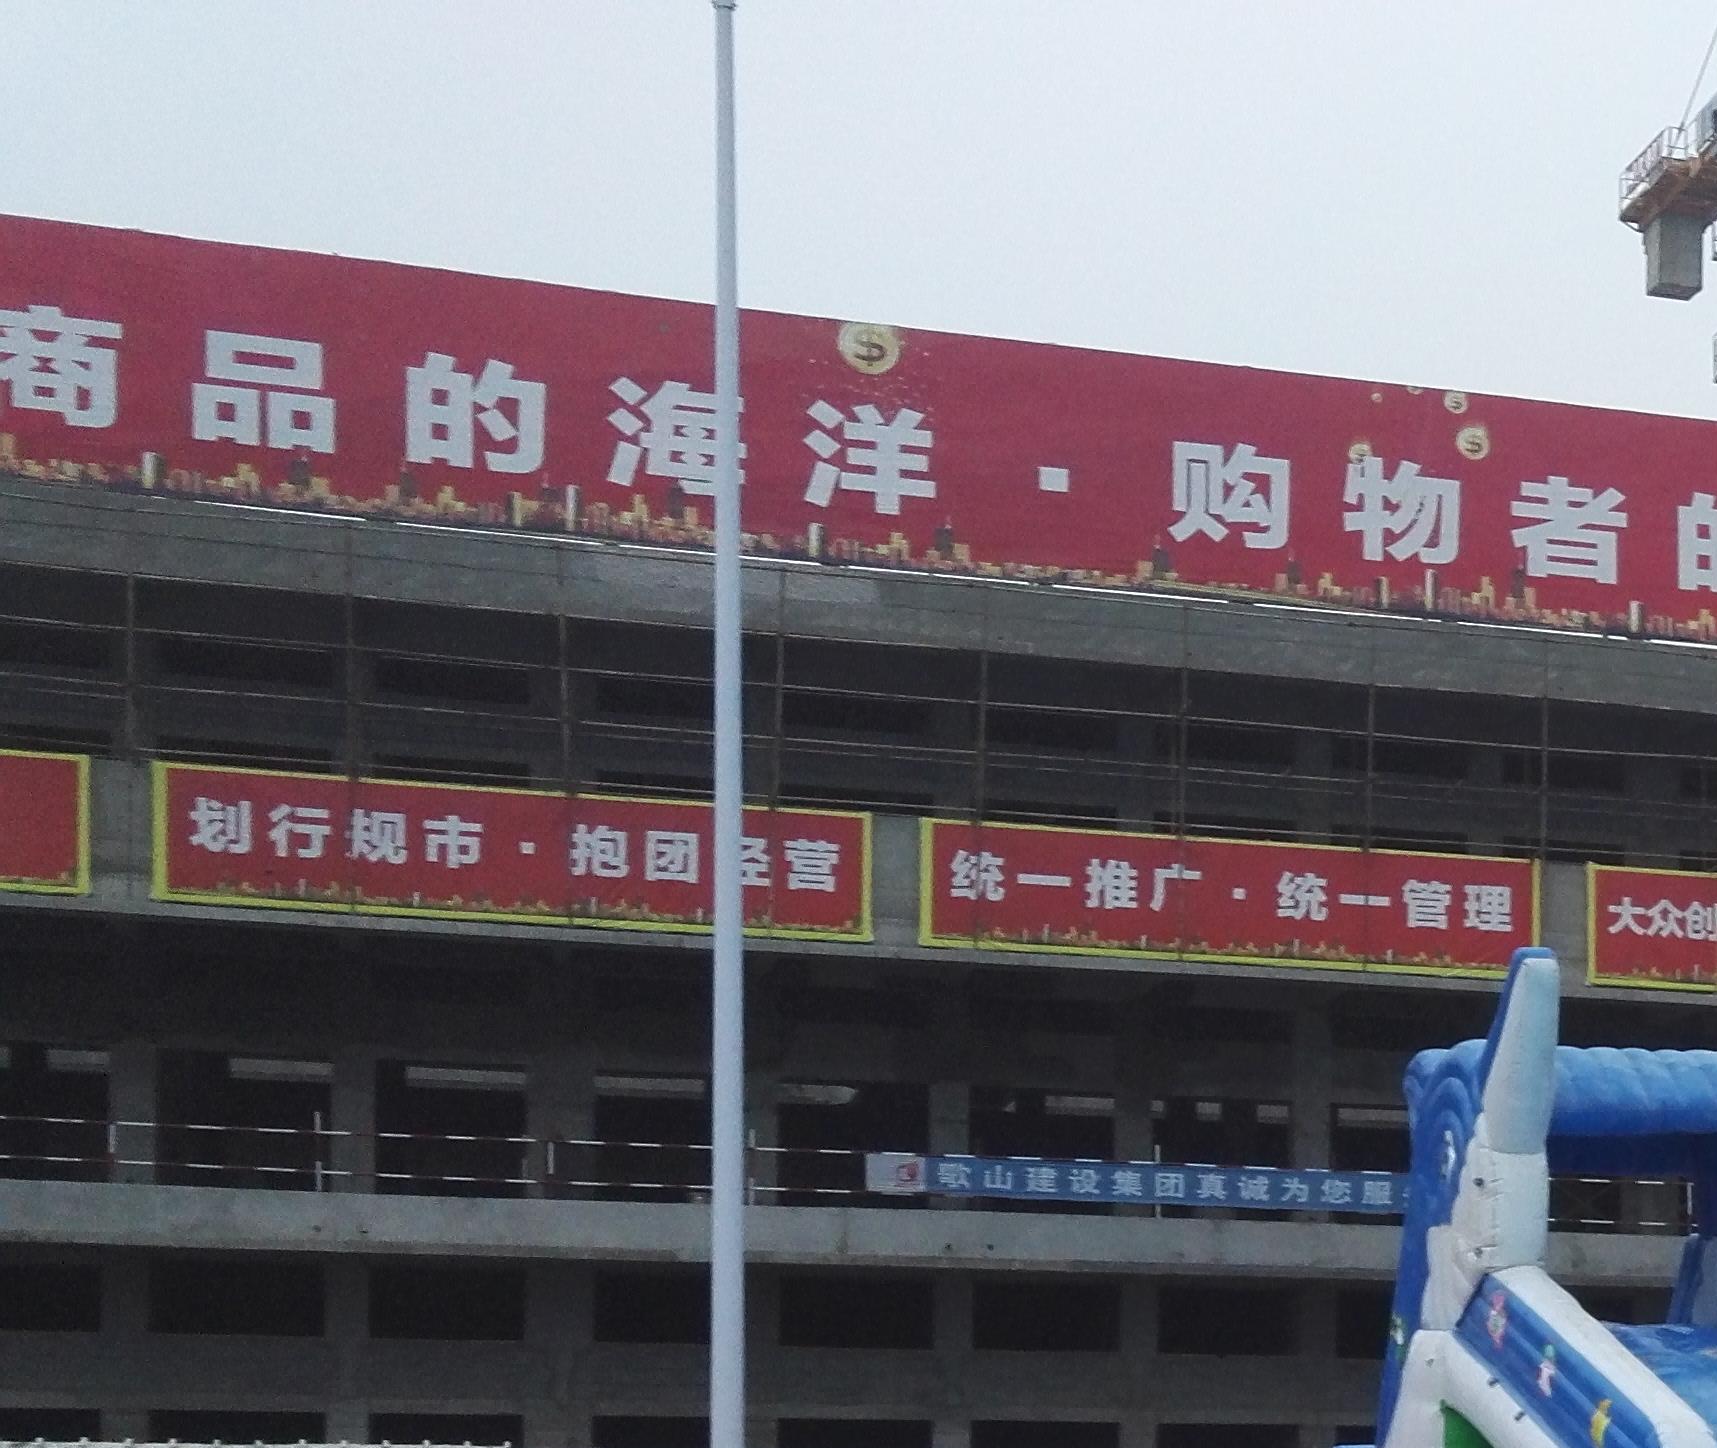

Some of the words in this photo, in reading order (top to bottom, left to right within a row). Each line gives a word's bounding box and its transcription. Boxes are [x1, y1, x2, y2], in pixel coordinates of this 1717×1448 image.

[936, 1162, 1408, 1205] 歌山建设集团真诚为您服
